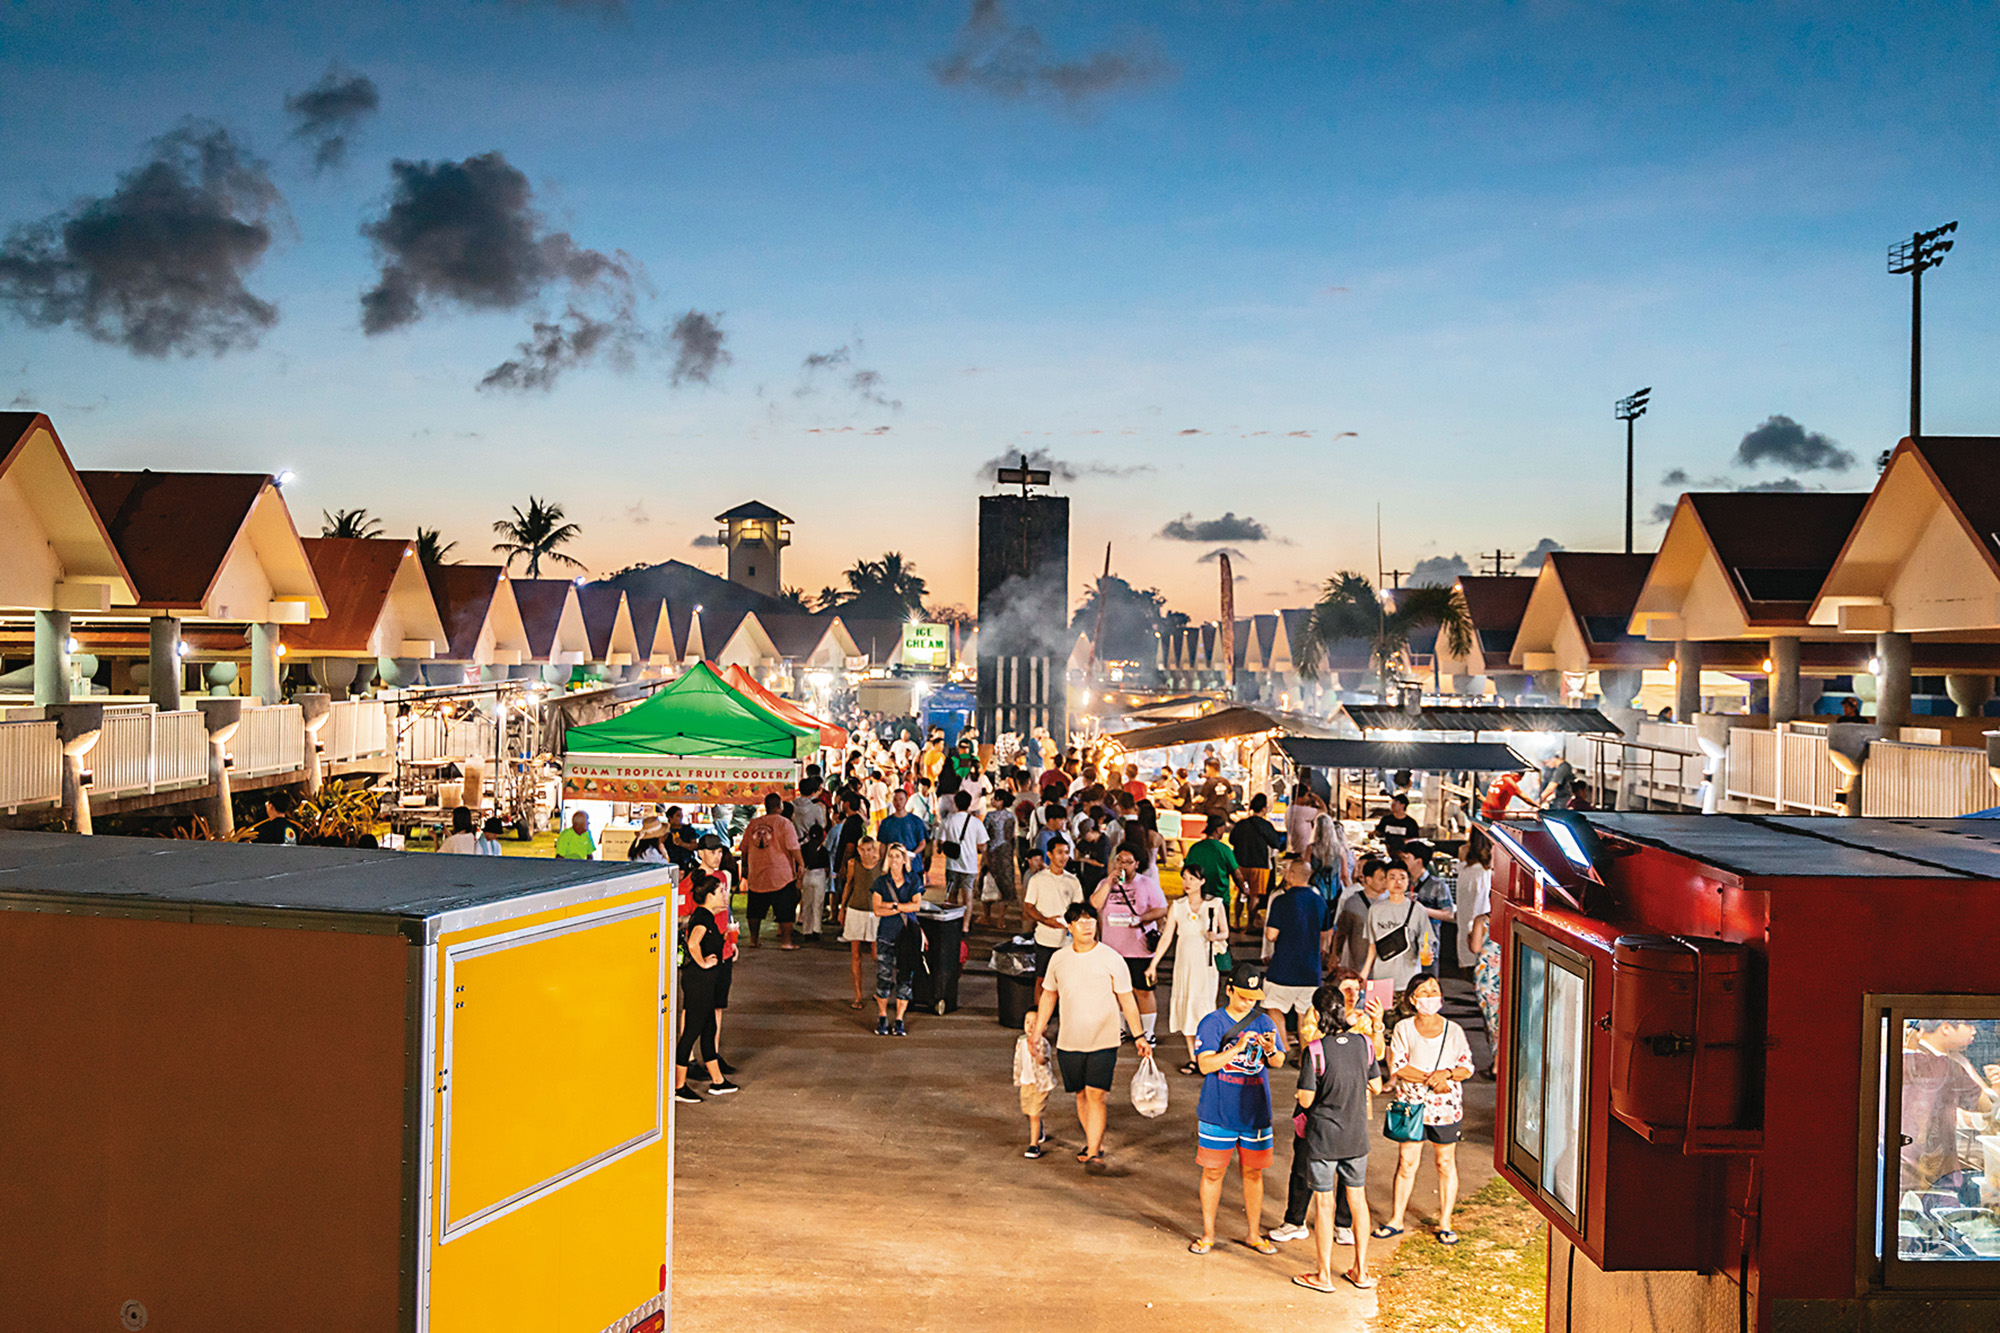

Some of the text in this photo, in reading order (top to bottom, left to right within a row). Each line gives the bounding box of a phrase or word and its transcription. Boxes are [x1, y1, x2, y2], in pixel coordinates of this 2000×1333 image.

[915, 628, 933, 637] ICE
[905, 639, 944, 649] CREAM
[572, 766, 790, 779] GUAM TROPICAL FRUIT COOLERS
